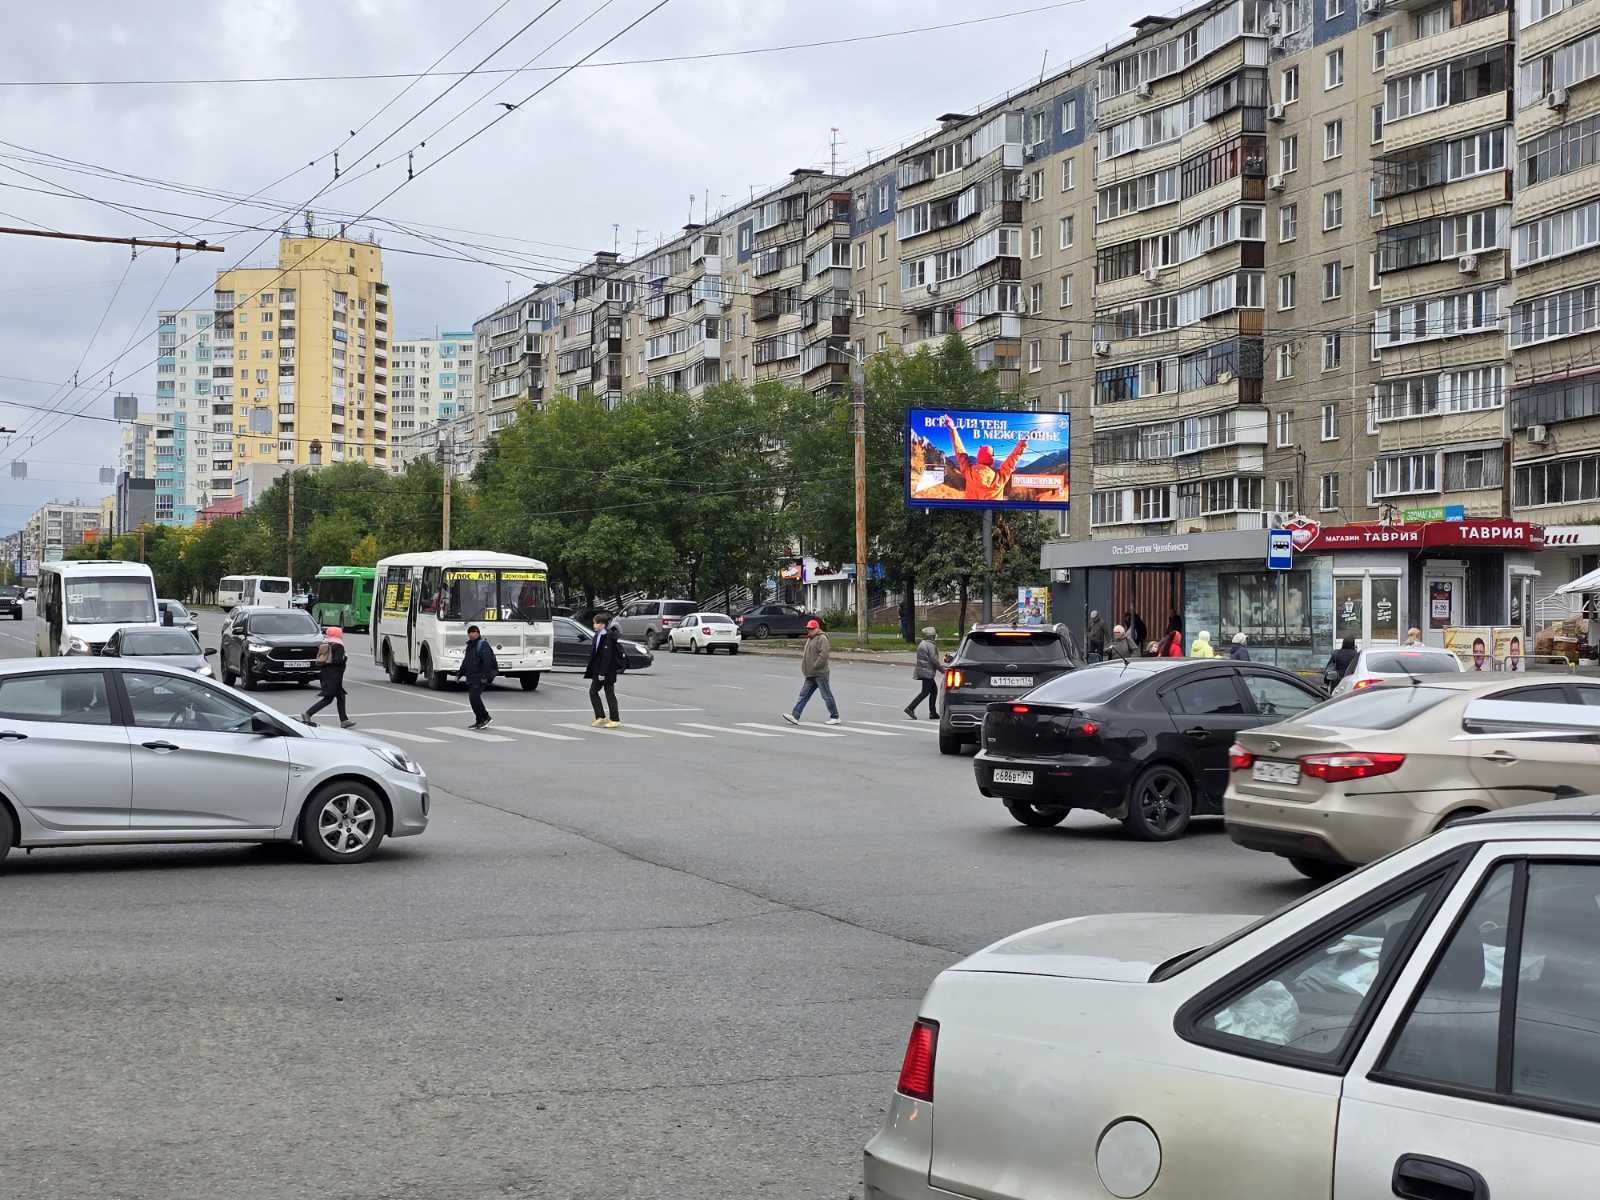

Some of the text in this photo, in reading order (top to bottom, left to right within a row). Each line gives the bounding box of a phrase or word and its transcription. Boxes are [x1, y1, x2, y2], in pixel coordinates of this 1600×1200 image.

[956, 417, 978, 429] ДЛЯ
[979, 419, 1007, 430] ТЕБЯ
[973, 430, 981, 439] В
[1364, 532, 1418, 542] ТАВРИЯ
[1459, 527, 1523, 539] ТАВРИЯ
[486, 609, 496, 619] 17
[501, 608, 512, 619] 17
